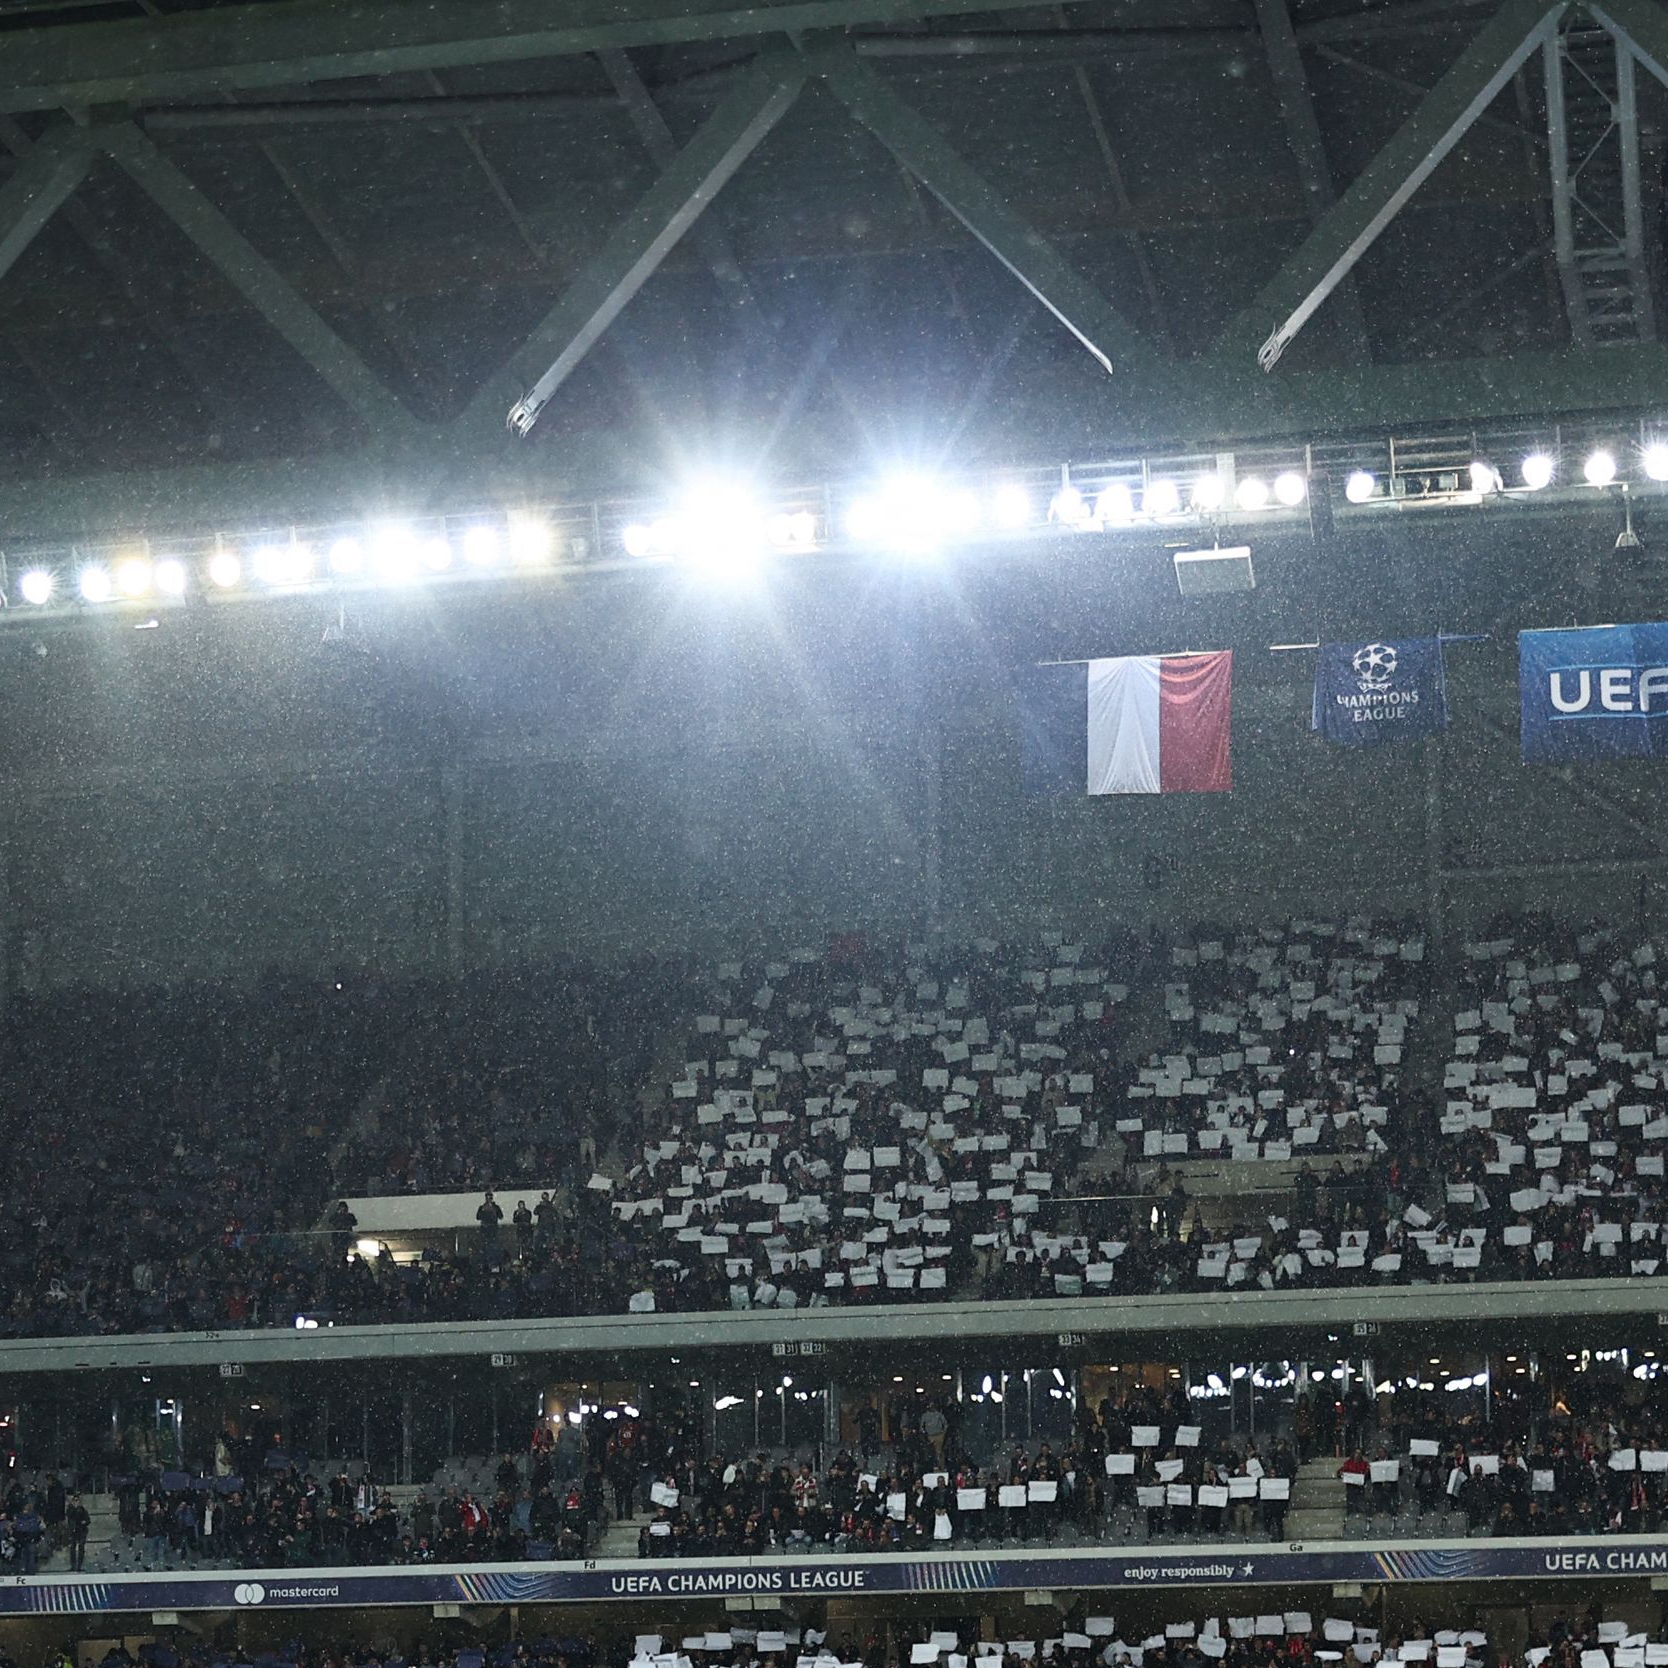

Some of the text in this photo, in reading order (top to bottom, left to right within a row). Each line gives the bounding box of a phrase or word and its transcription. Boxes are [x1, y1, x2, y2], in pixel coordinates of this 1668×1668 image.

[1354, 706, 1406, 722] EAGUE
[1289, 1543, 1303, 1552] Ga
[584, 1561, 596, 1569] Fd
[1545, 1553, 1601, 1570] UEFA
[1124, 1564, 1235, 1580] enjoy responsibly
[16, 1576, 26, 1585] Fc
[612, 1570, 865, 1592] UEFA CHAMPIONS LEAGUE
[270, 1585, 339, 1598] mastercard
